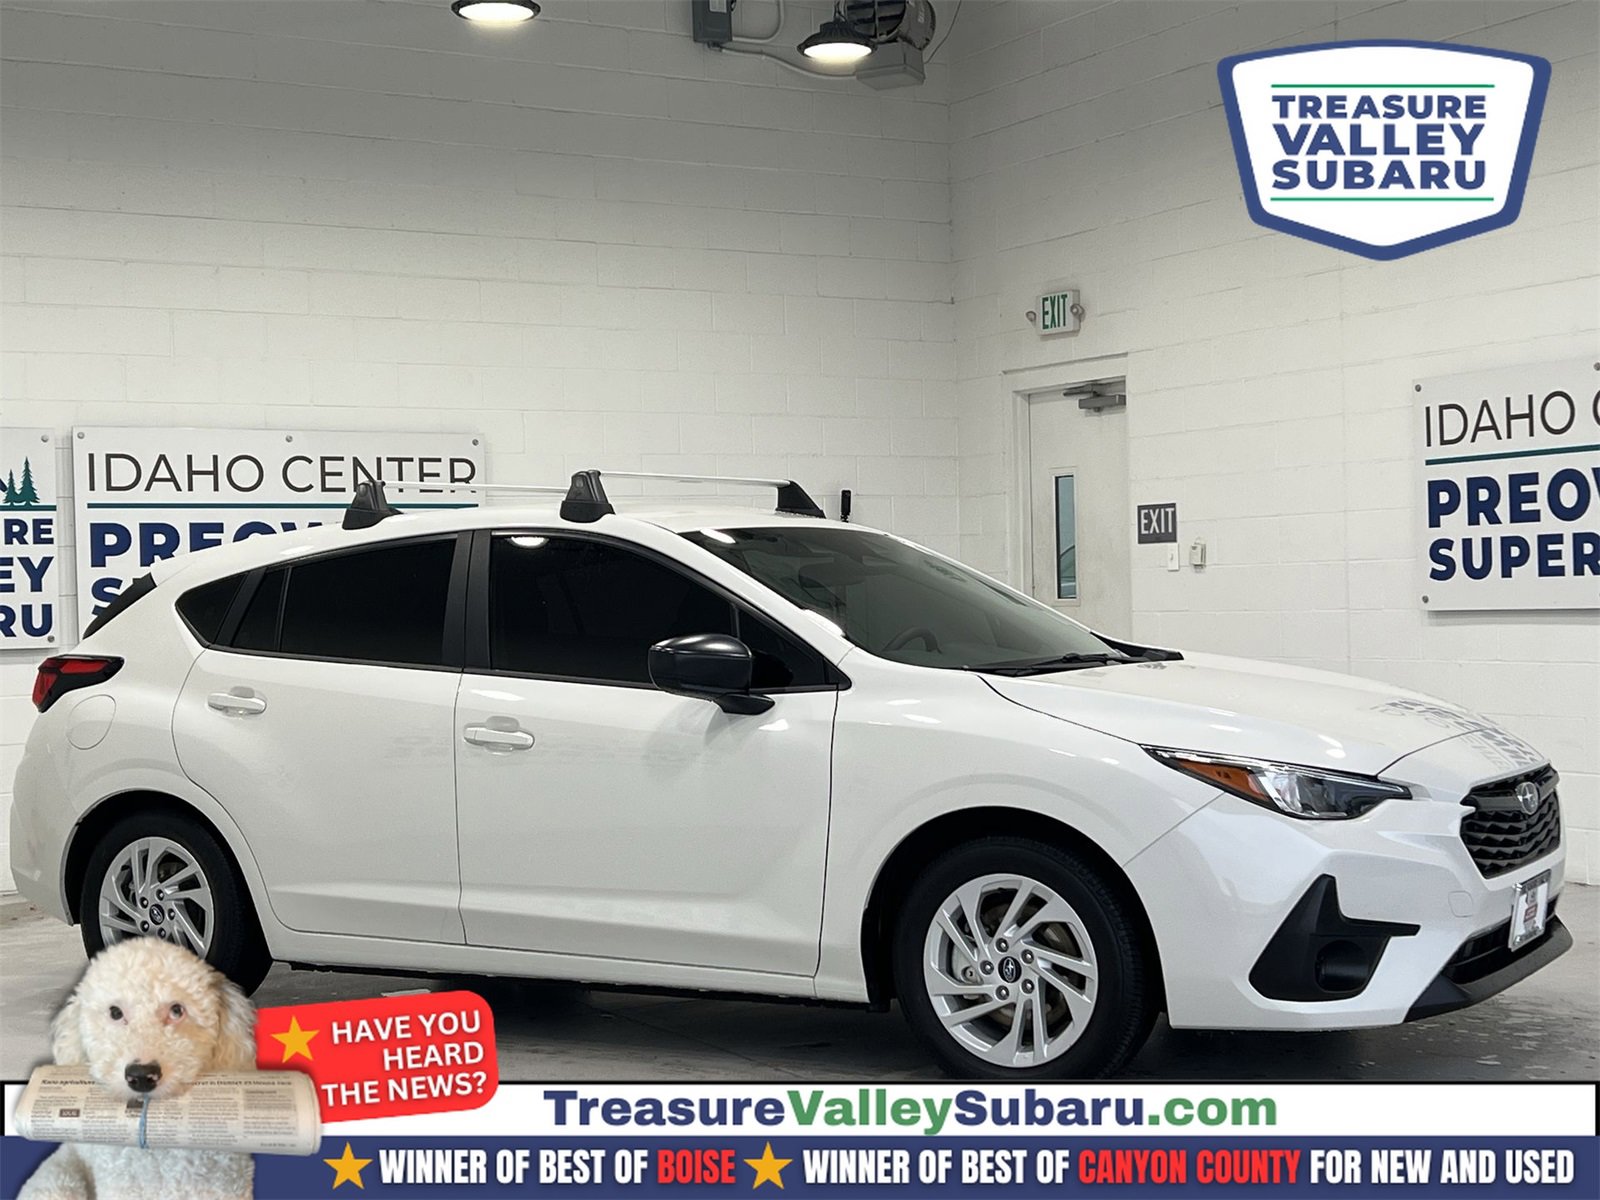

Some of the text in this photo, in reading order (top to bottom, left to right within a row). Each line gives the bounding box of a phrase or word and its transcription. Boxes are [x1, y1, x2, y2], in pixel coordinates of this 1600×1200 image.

[1041, 293, 1068, 330] EXIT
[1425, 390, 1576, 448] IDAHO
[87, 452, 478, 494] IDAHO CENTER
[1427, 466, 1600, 529] PREO
[3, 518, 54, 546] RE
[1140, 507, 1175, 535] EXIT
[1428, 531, 1600, 581] SUPER
